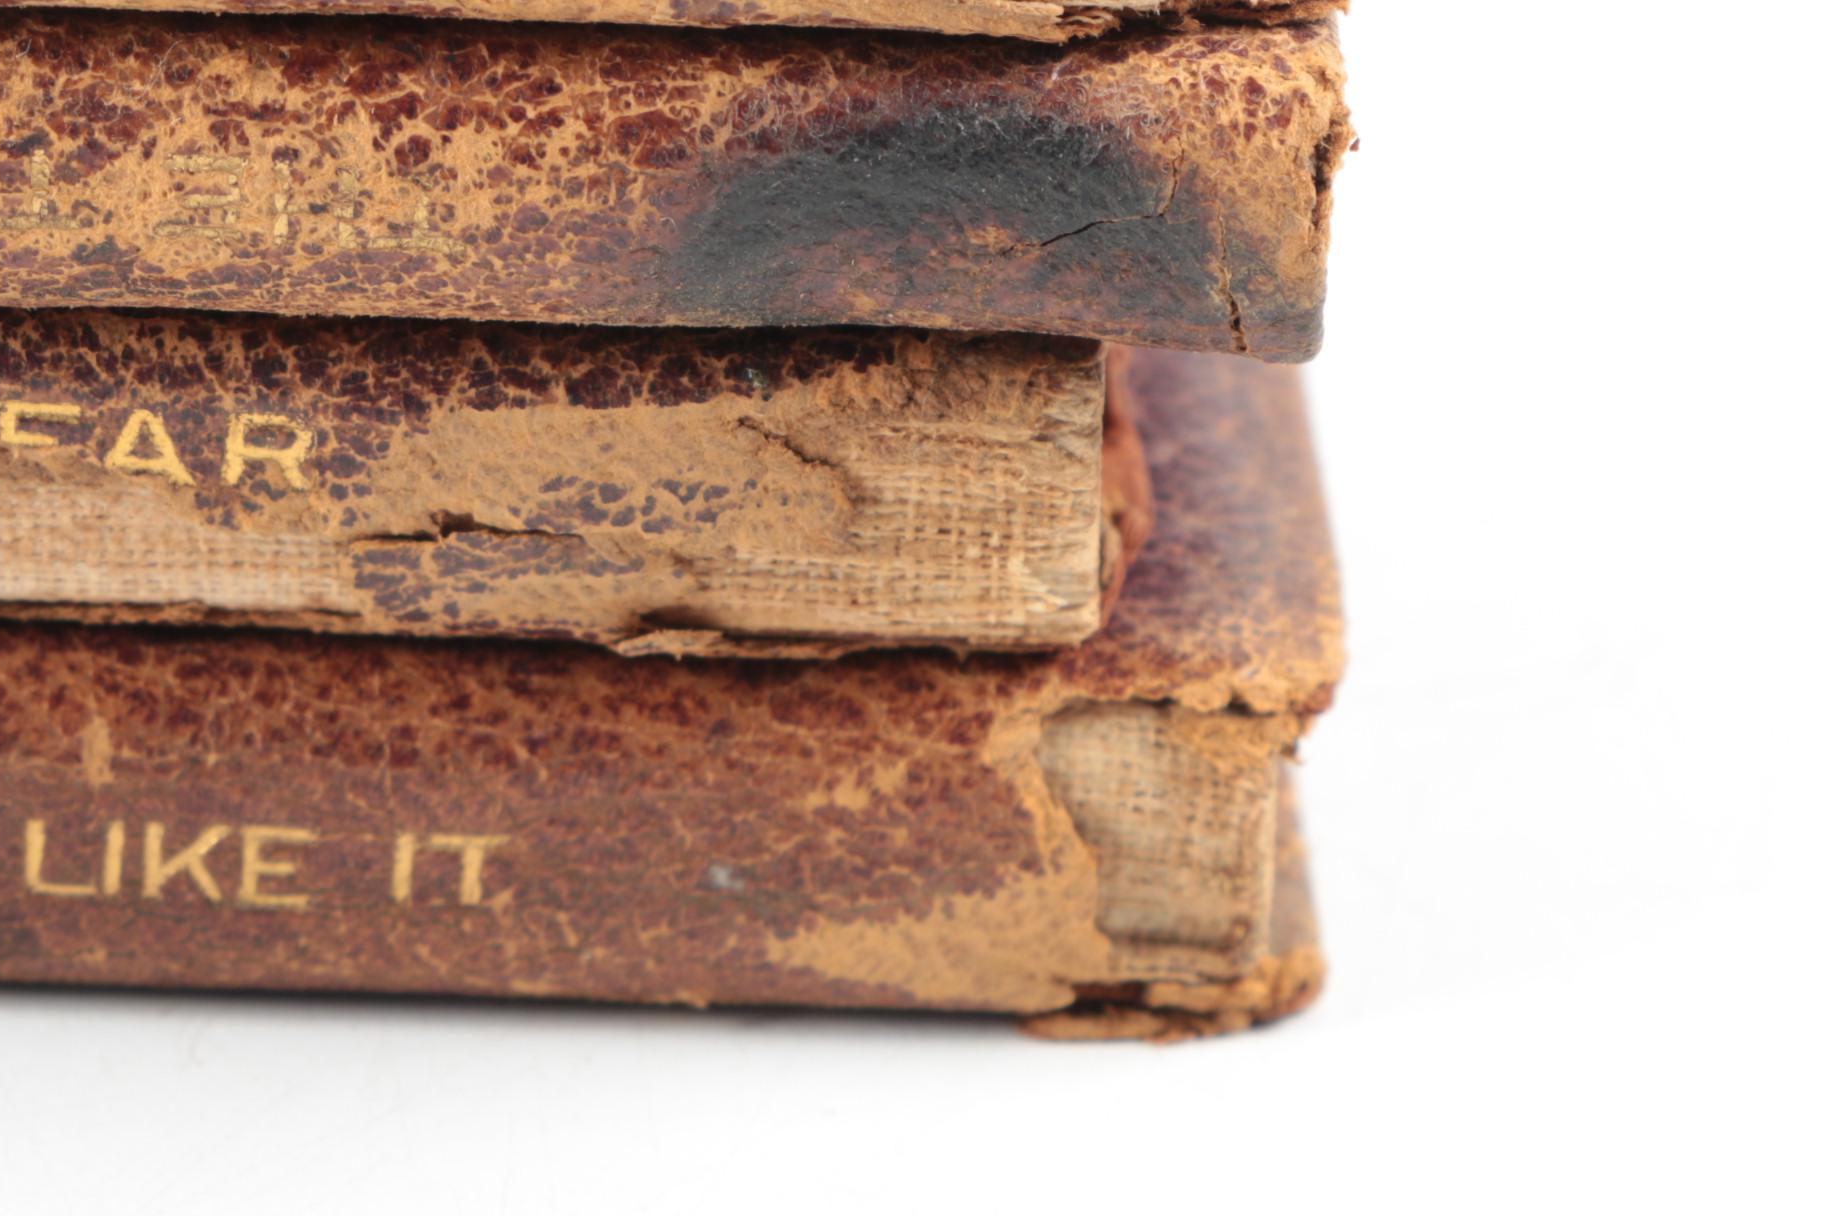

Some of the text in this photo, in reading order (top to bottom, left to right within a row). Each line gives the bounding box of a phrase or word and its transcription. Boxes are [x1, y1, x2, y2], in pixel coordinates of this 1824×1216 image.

[151, 152, 470, 254] THE
[23, 818, 318, 908] LIKE
[390, 831, 512, 906] IT
